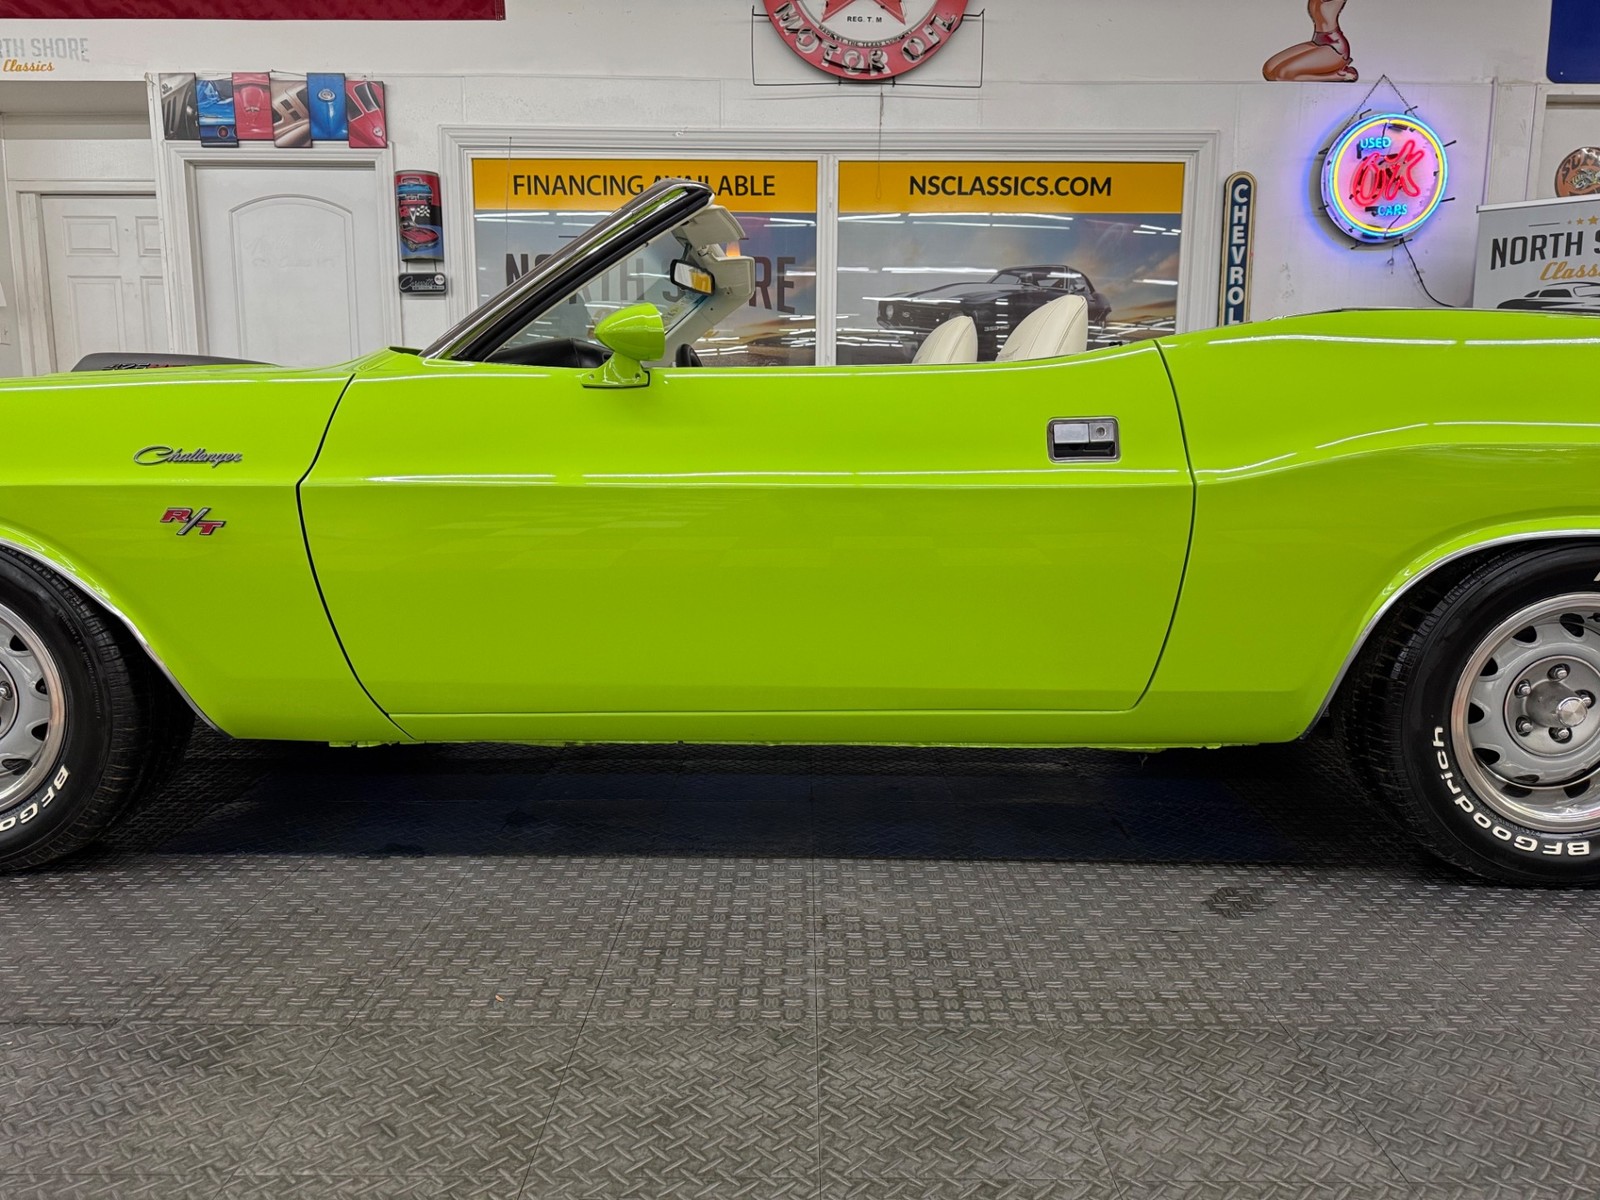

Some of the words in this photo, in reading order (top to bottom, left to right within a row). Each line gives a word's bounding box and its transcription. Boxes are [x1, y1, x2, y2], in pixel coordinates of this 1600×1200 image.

[0, 37, 26, 58] TH
[30, 37, 90, 63] SHORE
[774, 2, 893, 76] MOTOR
[902, 12, 958, 63] OIL
[2, 58, 56, 72] Classics
[1360, 136, 1392, 149] USED
[513, 174, 644, 196] FINANCING
[909, 175, 1112, 197] NSCLASSICS.COM
[1352, 139, 1425, 207] OK
[1377, 203, 1408, 216] CARS
[1227, 183, 1249, 325] CHEVROL
[1490, 230, 1584, 271] NORTH
[133, 445, 243, 468] Challenger
[160, 507, 227, 536] R/T
[1432, 726, 1590, 856] BFGoodrich
